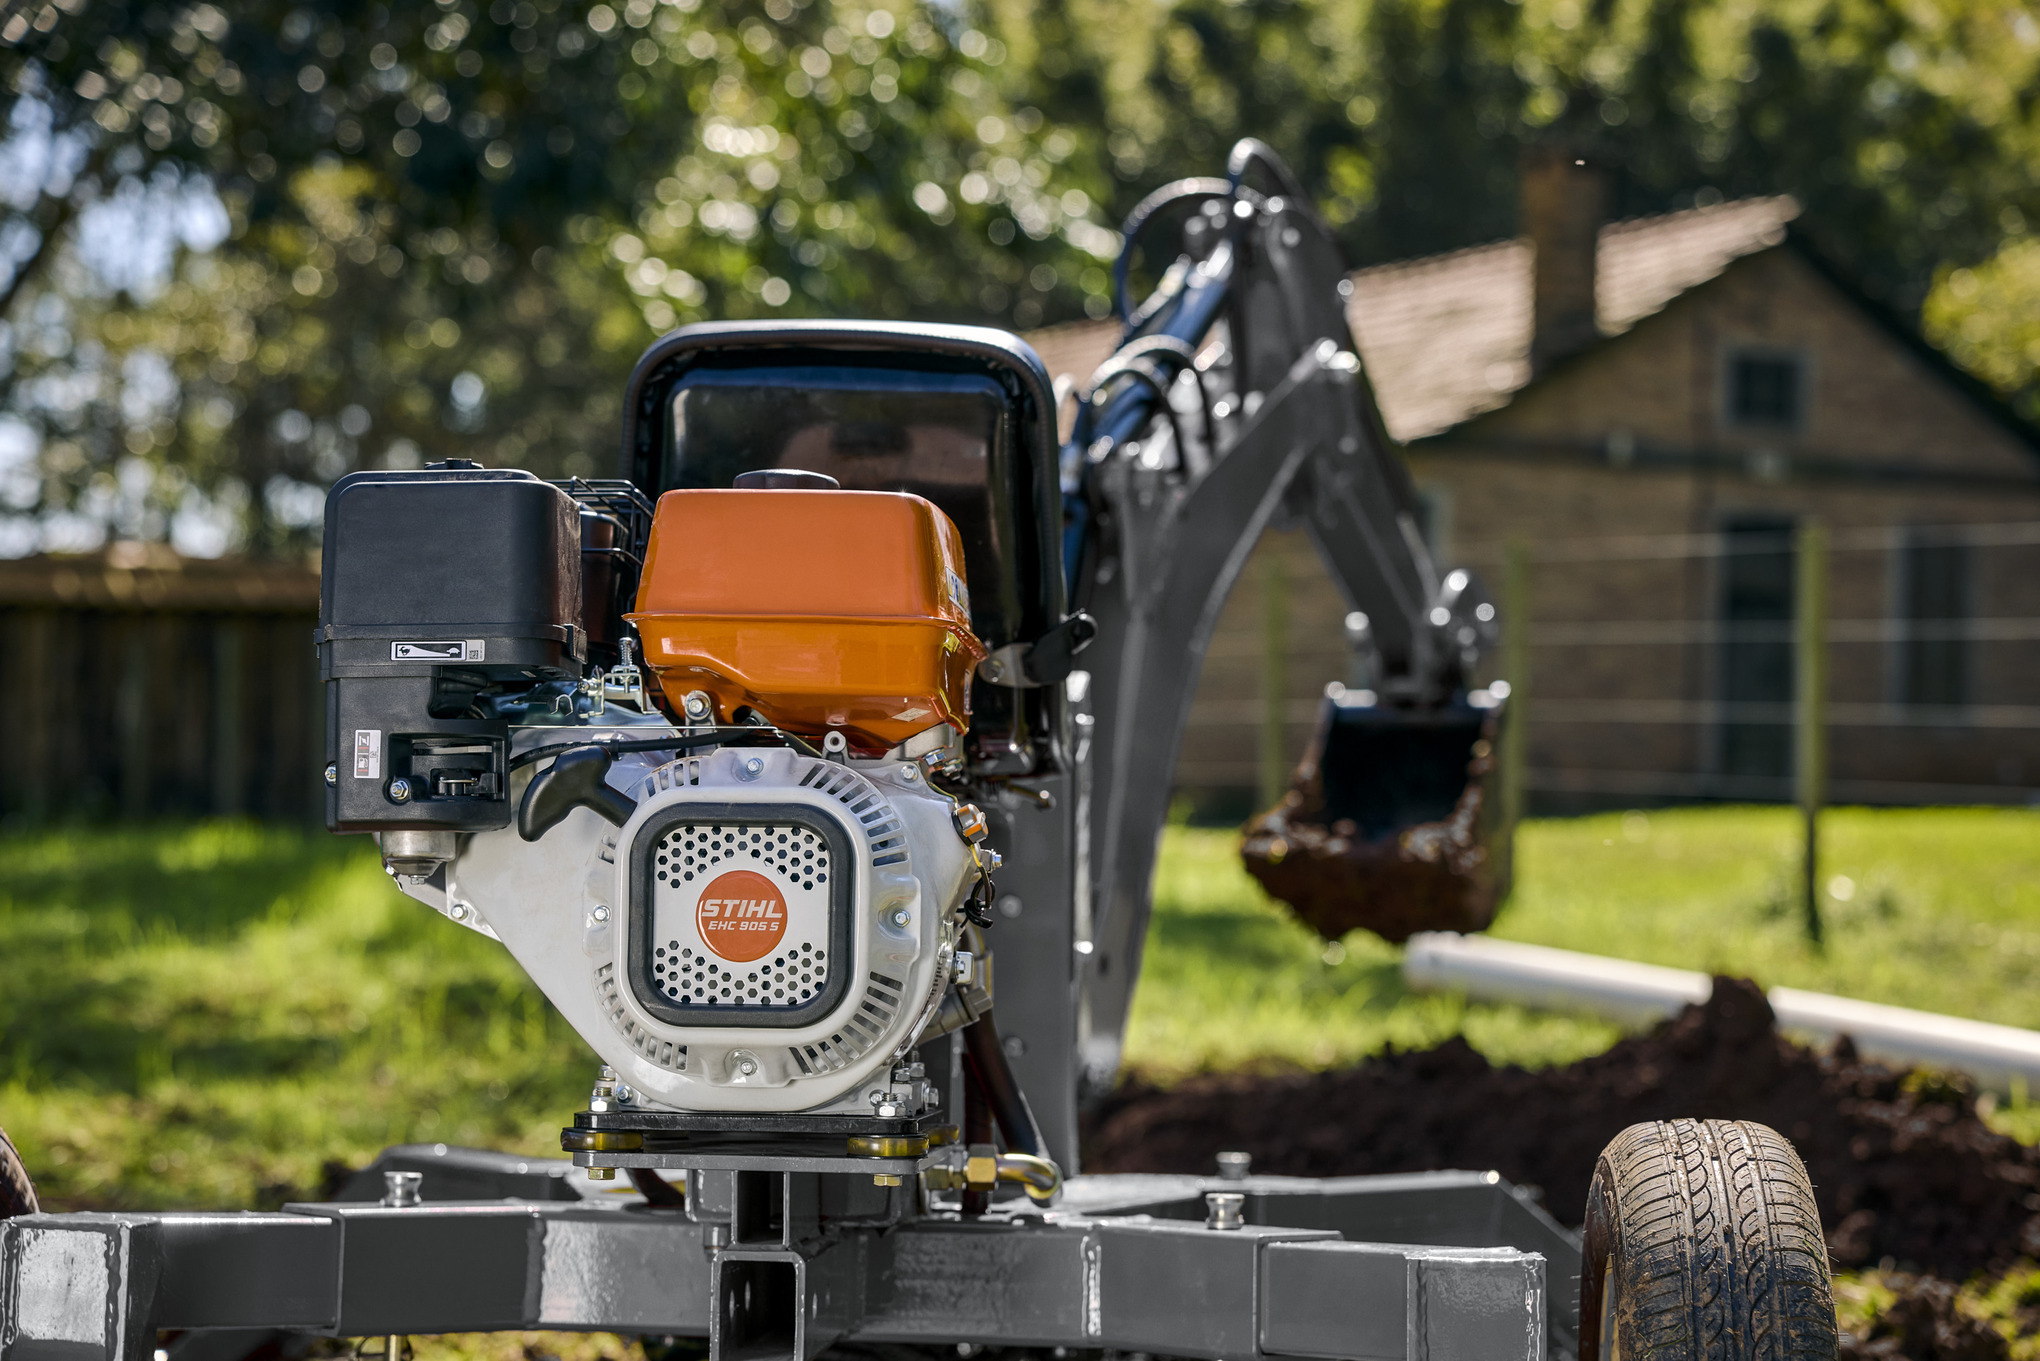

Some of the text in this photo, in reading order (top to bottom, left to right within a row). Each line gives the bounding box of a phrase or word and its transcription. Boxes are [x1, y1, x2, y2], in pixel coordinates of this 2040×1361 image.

[701, 899, 783, 918] STIHL
[708, 921, 780, 931] EHC 905 S
